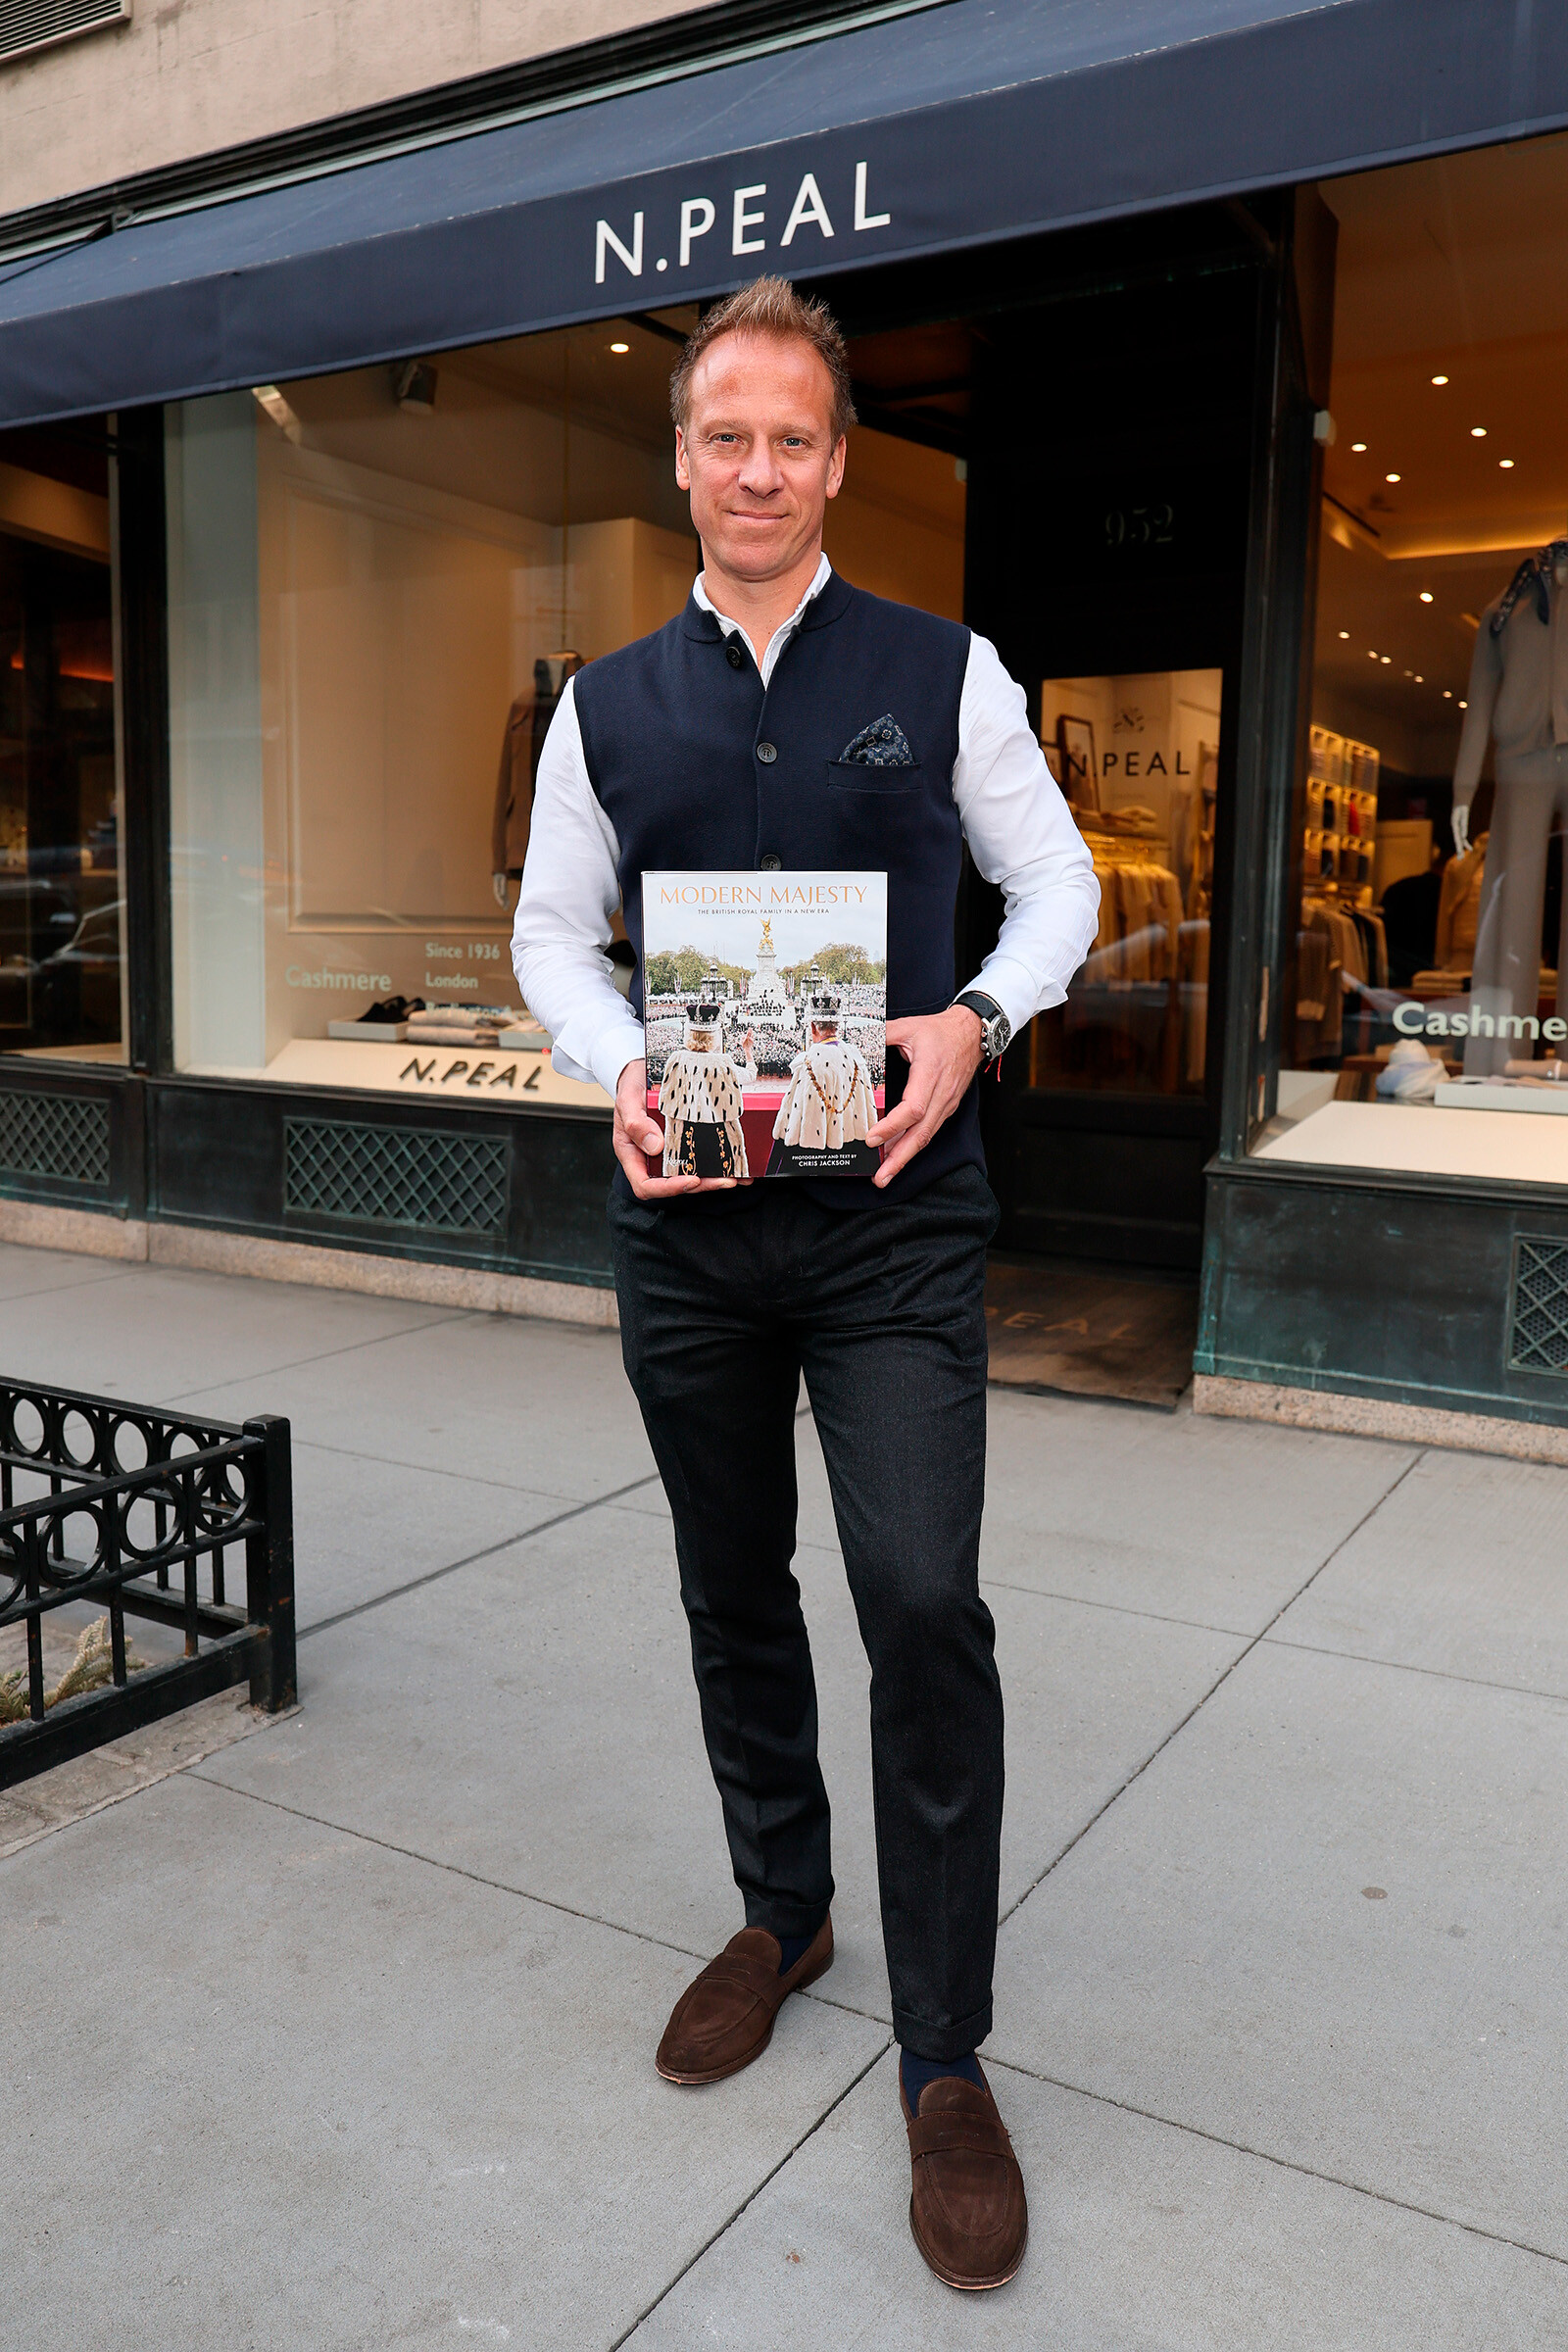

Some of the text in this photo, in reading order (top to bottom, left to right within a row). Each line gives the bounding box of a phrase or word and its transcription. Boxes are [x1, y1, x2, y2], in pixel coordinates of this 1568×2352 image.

[594, 160, 892, 284] N.PEAL
[1104, 503, 1174, 547] 952
[1066, 750, 1191, 777] N.PEAL
[660, 885, 868, 906] MODERN MAJESTY
[425, 942, 501, 960] Since 1936
[284, 964, 392, 992] Cashmere
[425, 971, 479, 989] London
[1392, 1001, 1568, 1042] Cashme
[399, 1057, 543, 1091] N.PEAL
